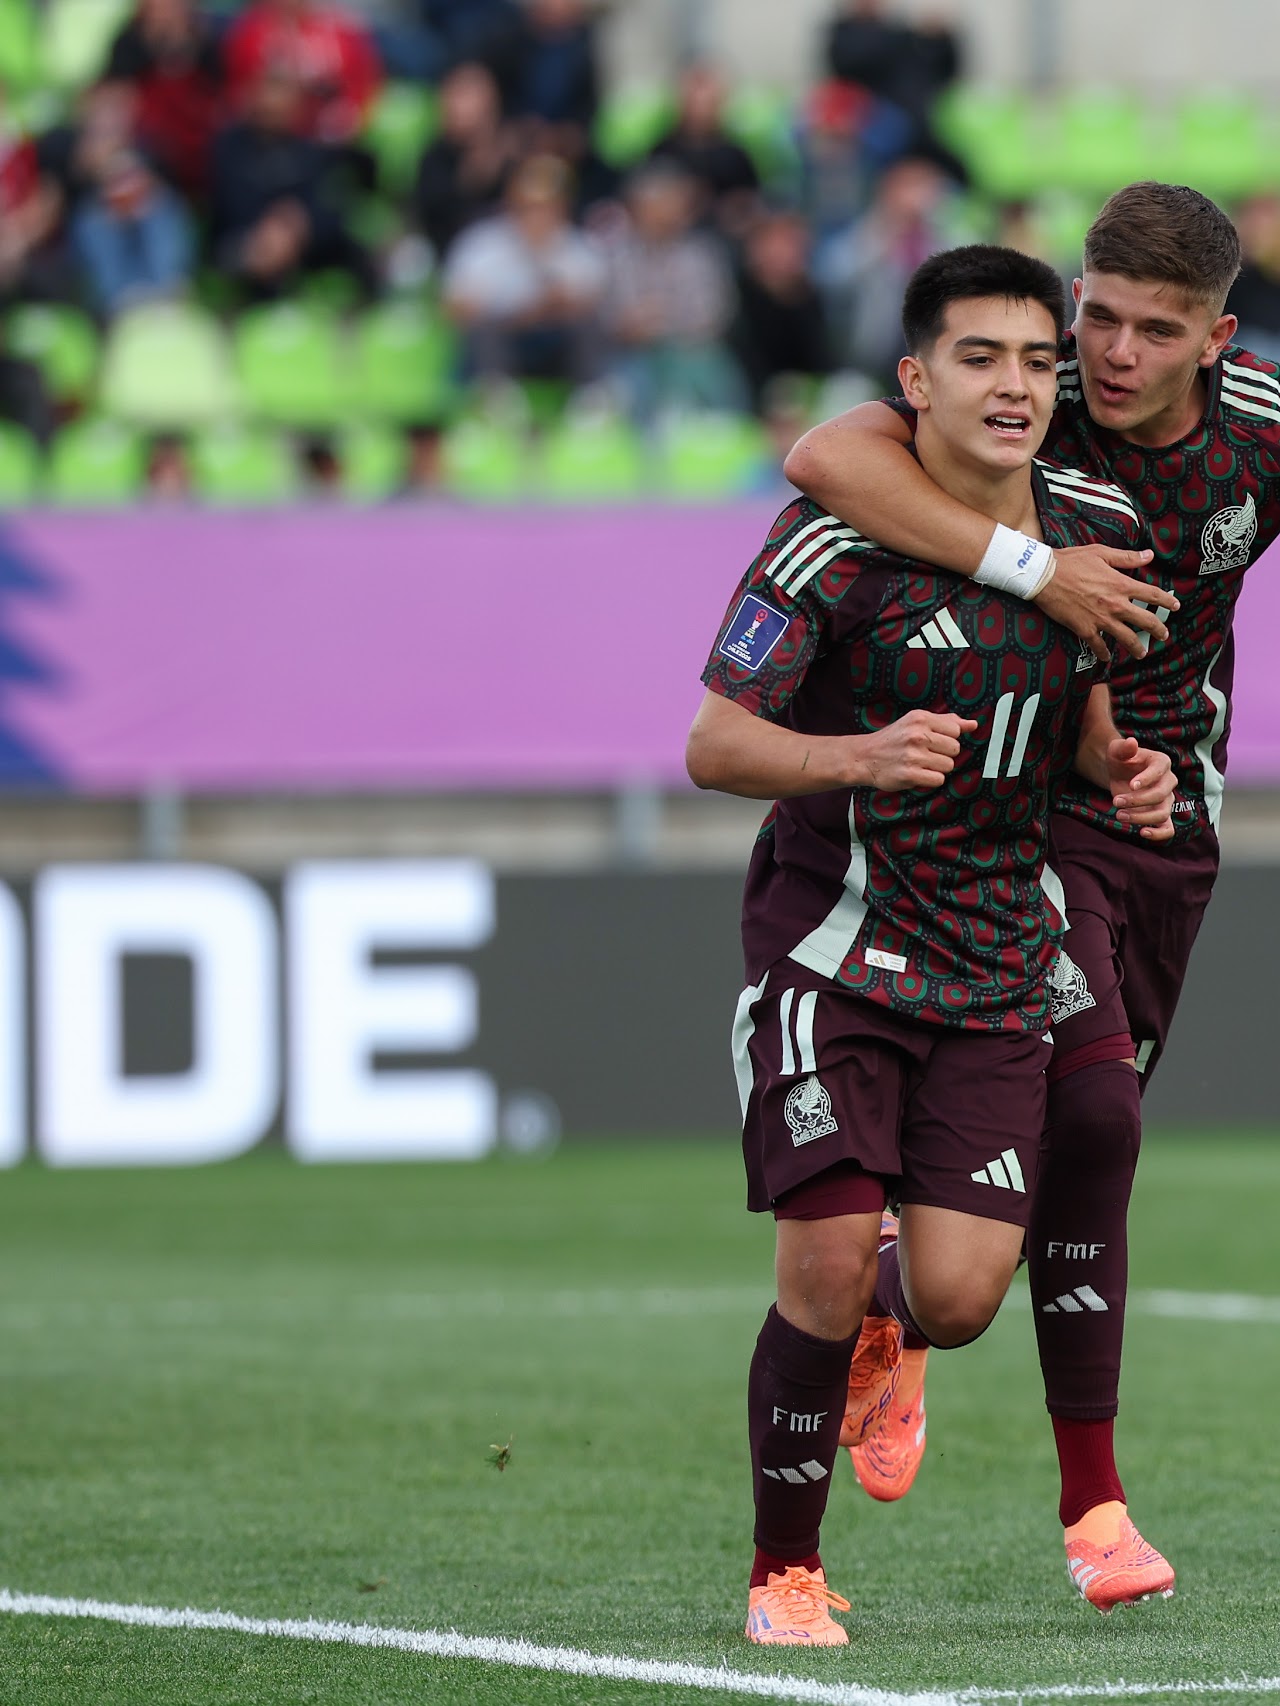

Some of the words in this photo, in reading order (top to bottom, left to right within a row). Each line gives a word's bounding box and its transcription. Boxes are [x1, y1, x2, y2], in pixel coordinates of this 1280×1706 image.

[982, 691, 1041, 779] 11
[0, 857, 500, 1170] DE
[779, 987, 819, 1076] 11
[1047, 1241, 1106, 1259] FMF
[772, 1405, 829, 1433] FMF
